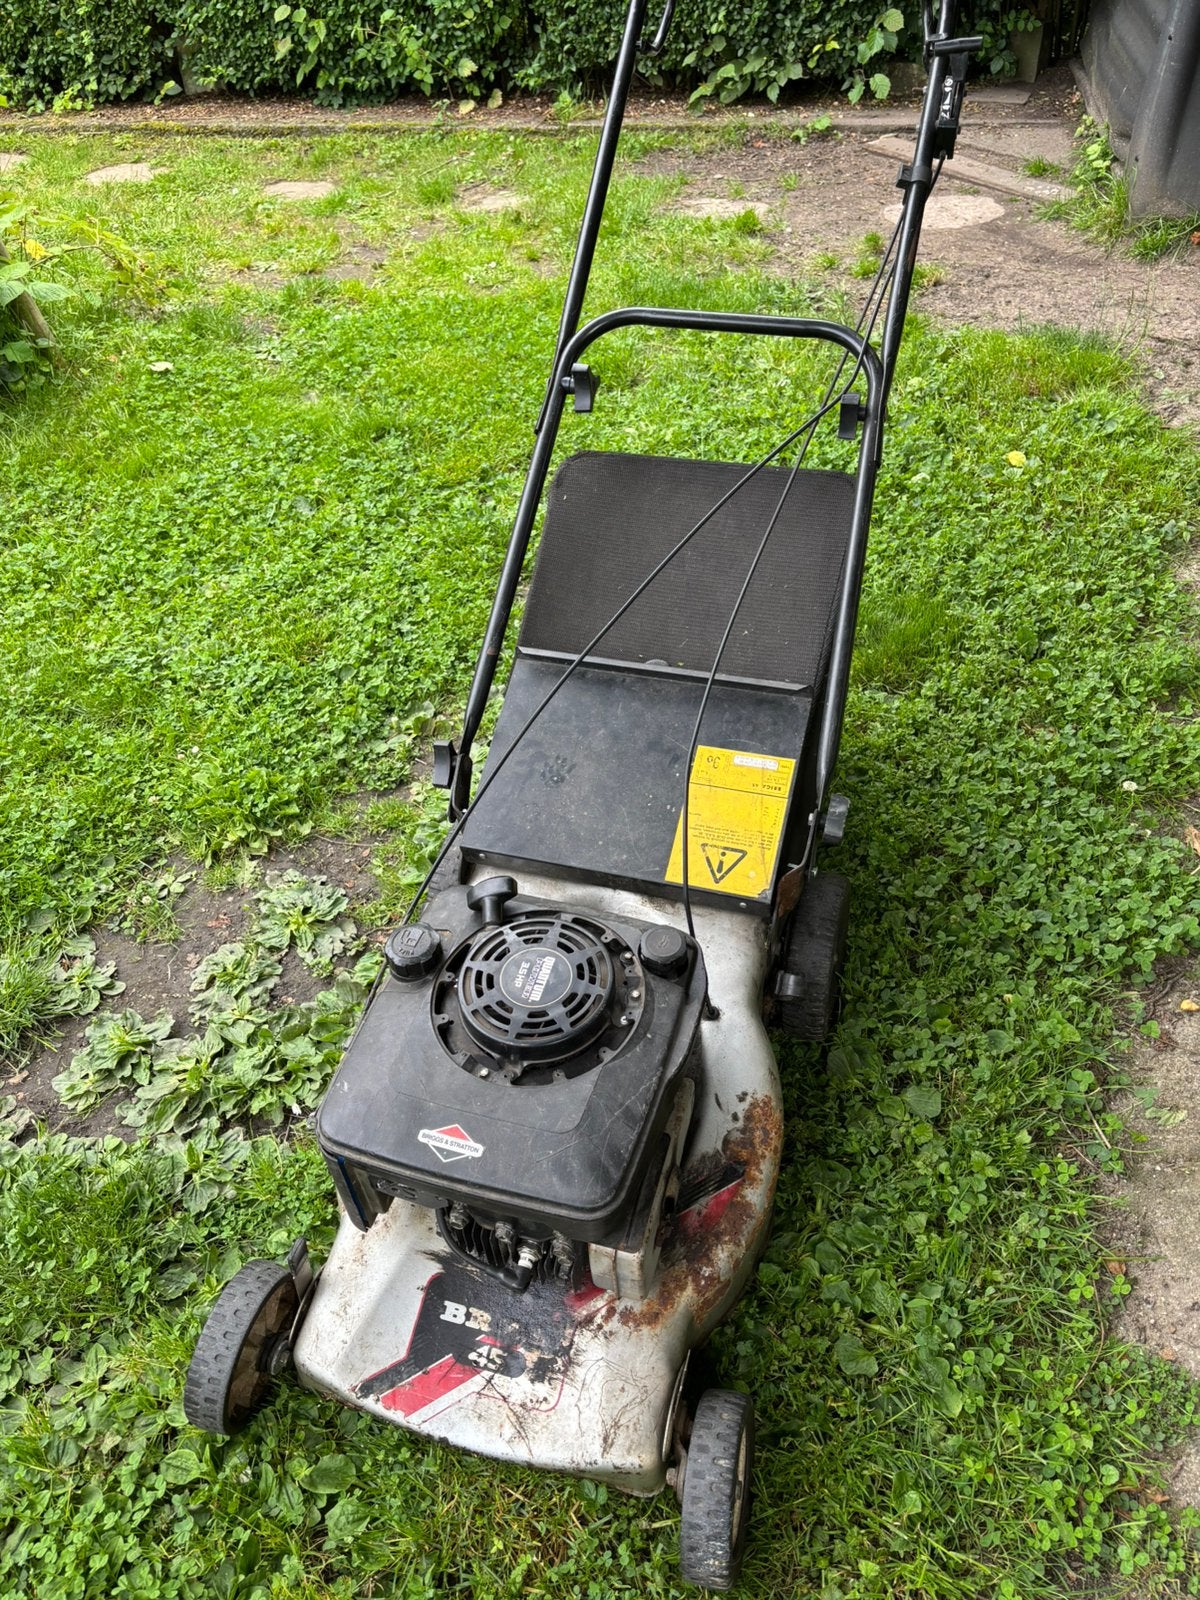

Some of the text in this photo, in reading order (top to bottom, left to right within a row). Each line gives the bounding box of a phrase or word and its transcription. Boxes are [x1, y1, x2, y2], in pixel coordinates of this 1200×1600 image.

[528, 956, 556, 1002] QUANTUM
[421, 1132, 444, 1144] BRIGGS
[449, 1140, 480, 1154] STRATTON
